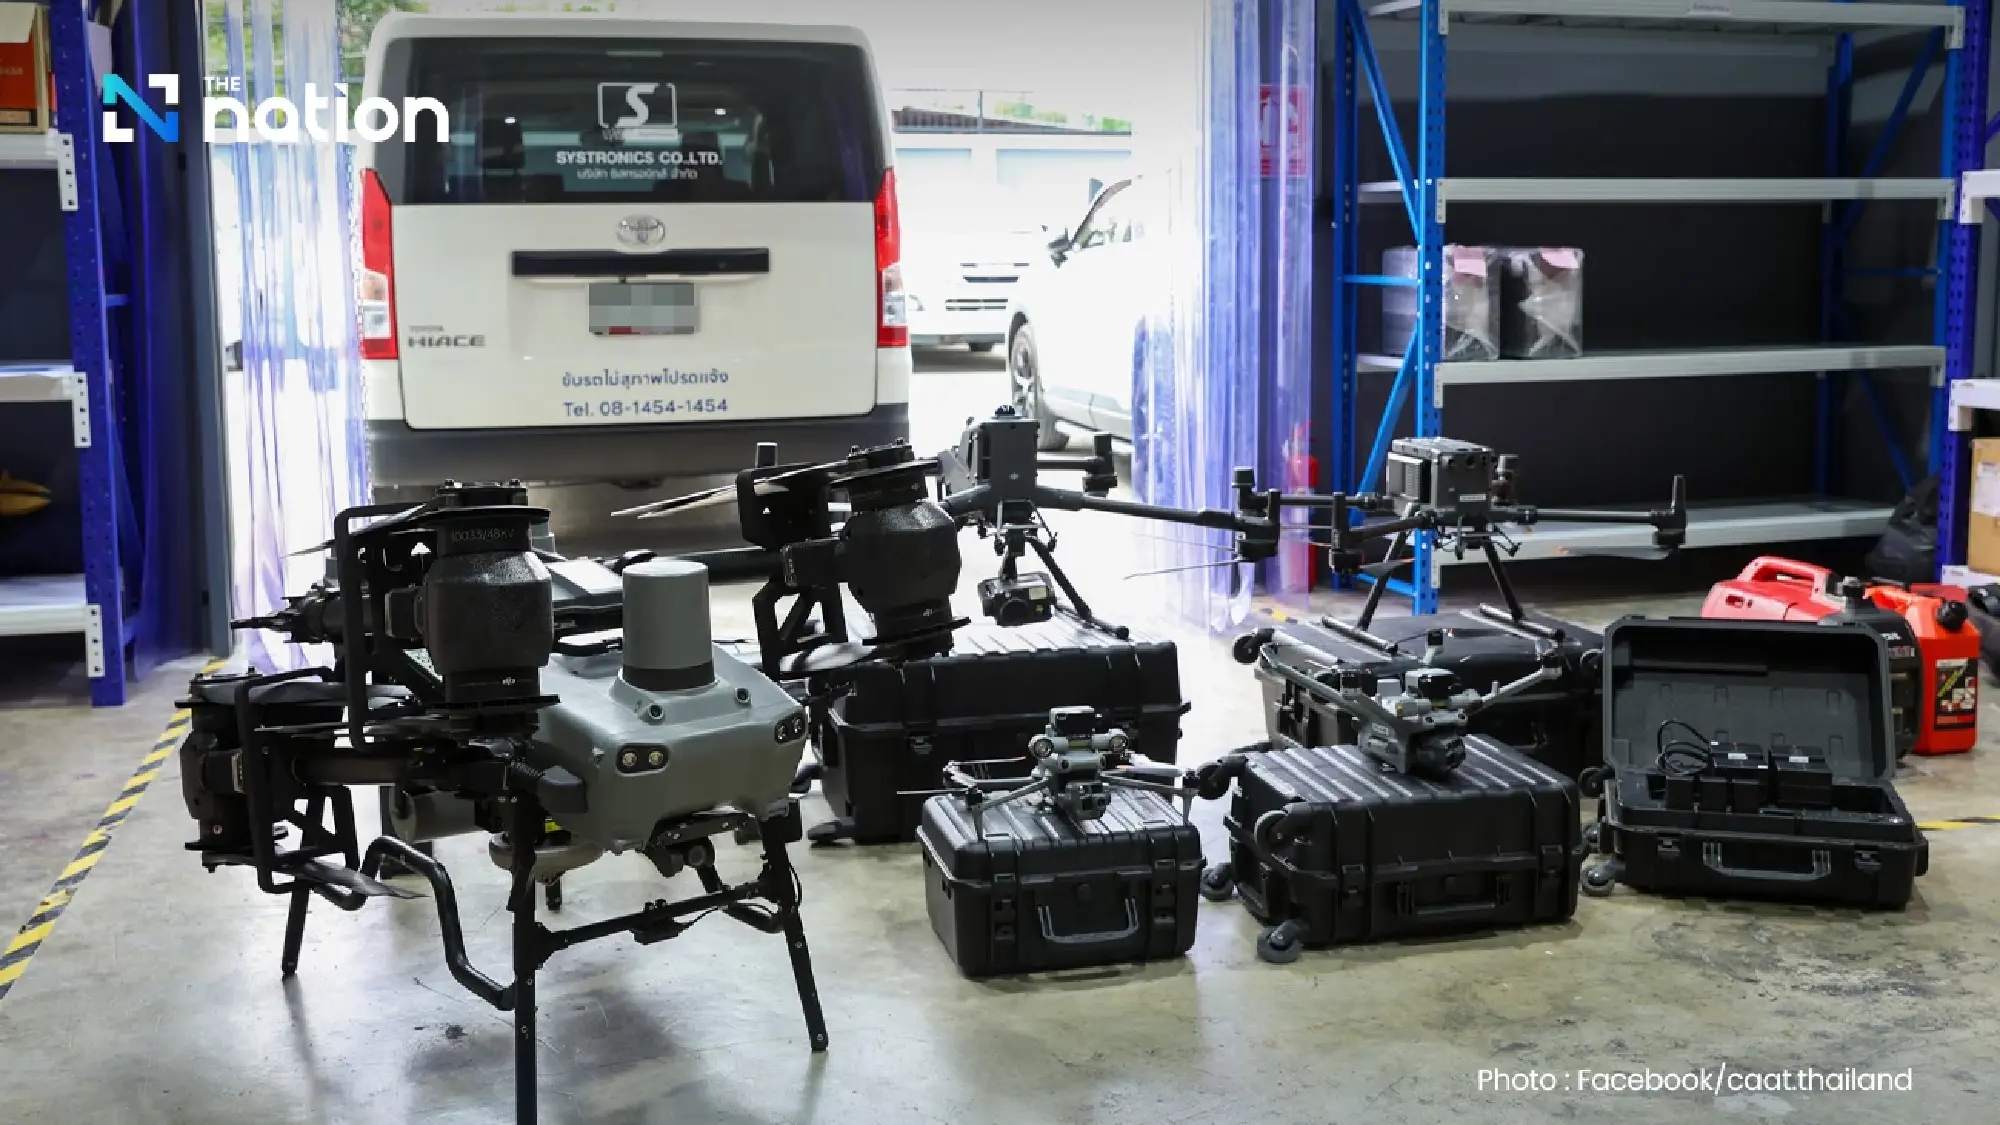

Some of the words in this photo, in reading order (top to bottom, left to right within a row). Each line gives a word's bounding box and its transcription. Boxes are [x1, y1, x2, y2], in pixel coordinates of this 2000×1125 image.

[556, 151, 654, 165] SYSTRONICS
[408, 334, 486, 348] HIACE
[562, 401, 595, 417] Tel.
[600, 398, 728, 417] 08-1454-1454
